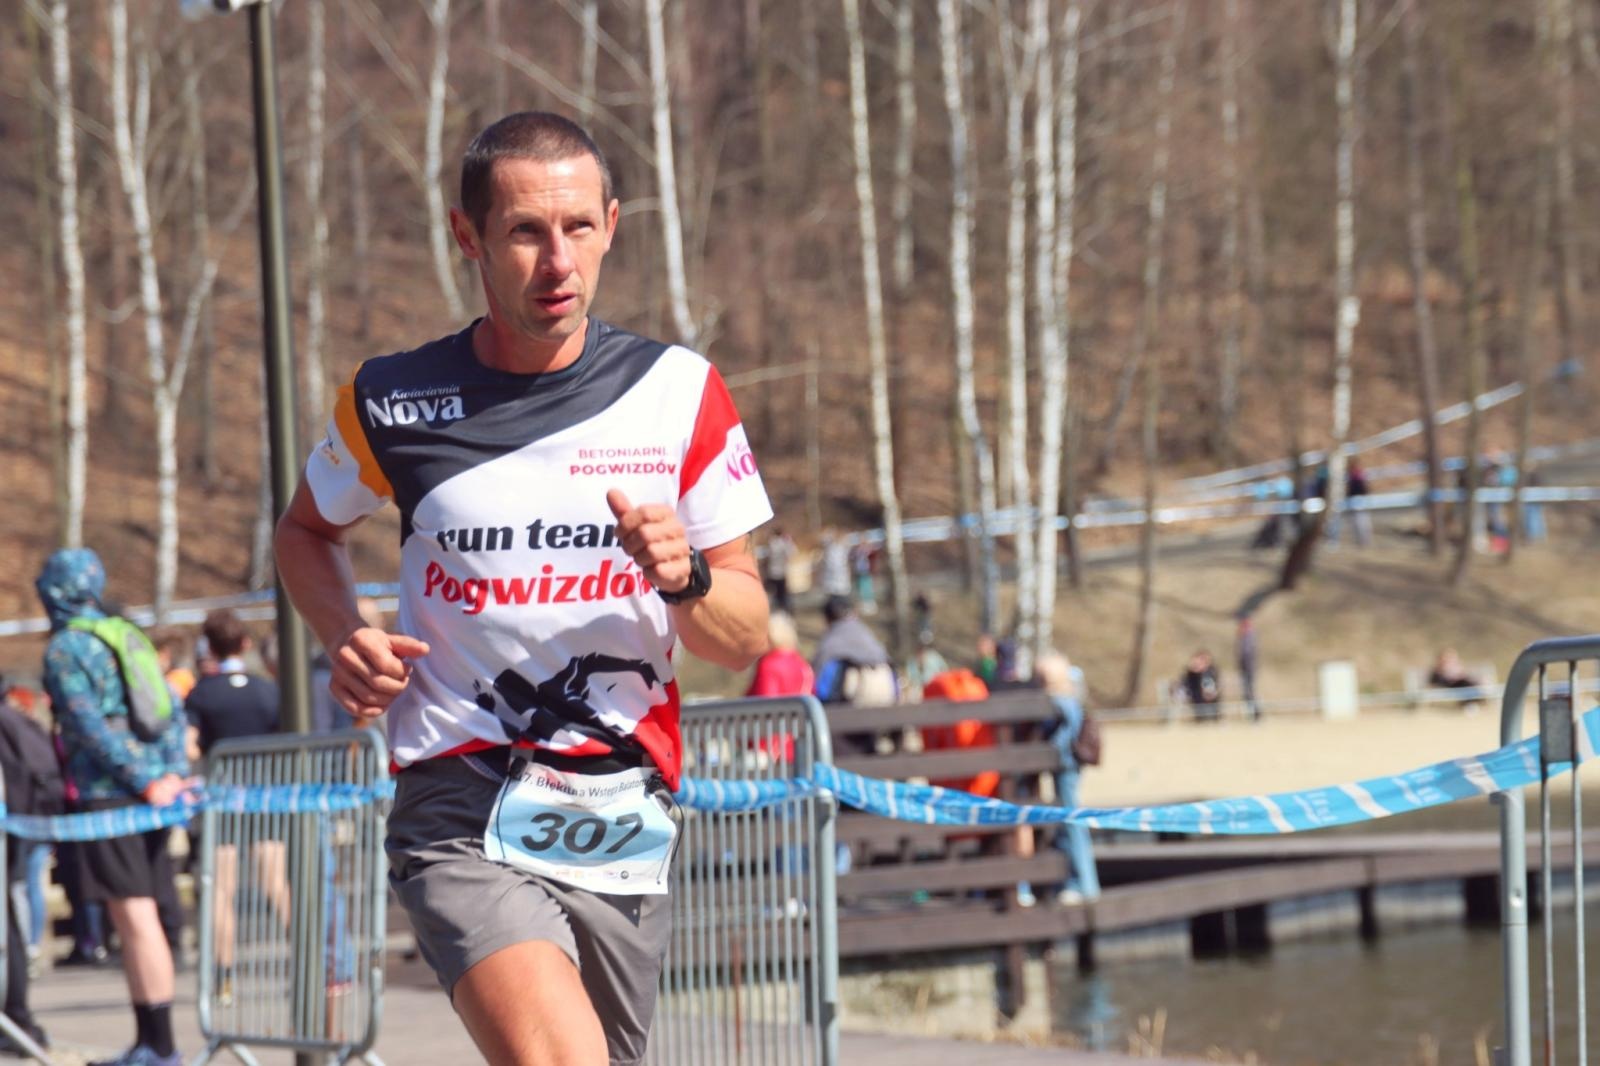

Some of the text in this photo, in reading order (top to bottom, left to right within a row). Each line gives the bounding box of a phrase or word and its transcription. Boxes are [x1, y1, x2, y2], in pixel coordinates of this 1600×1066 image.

[365, 396, 466, 428] Nova
[579, 446, 668, 459] BETONIARNI
[437, 525, 514, 552] run
[520, 812, 645, 855] 307
